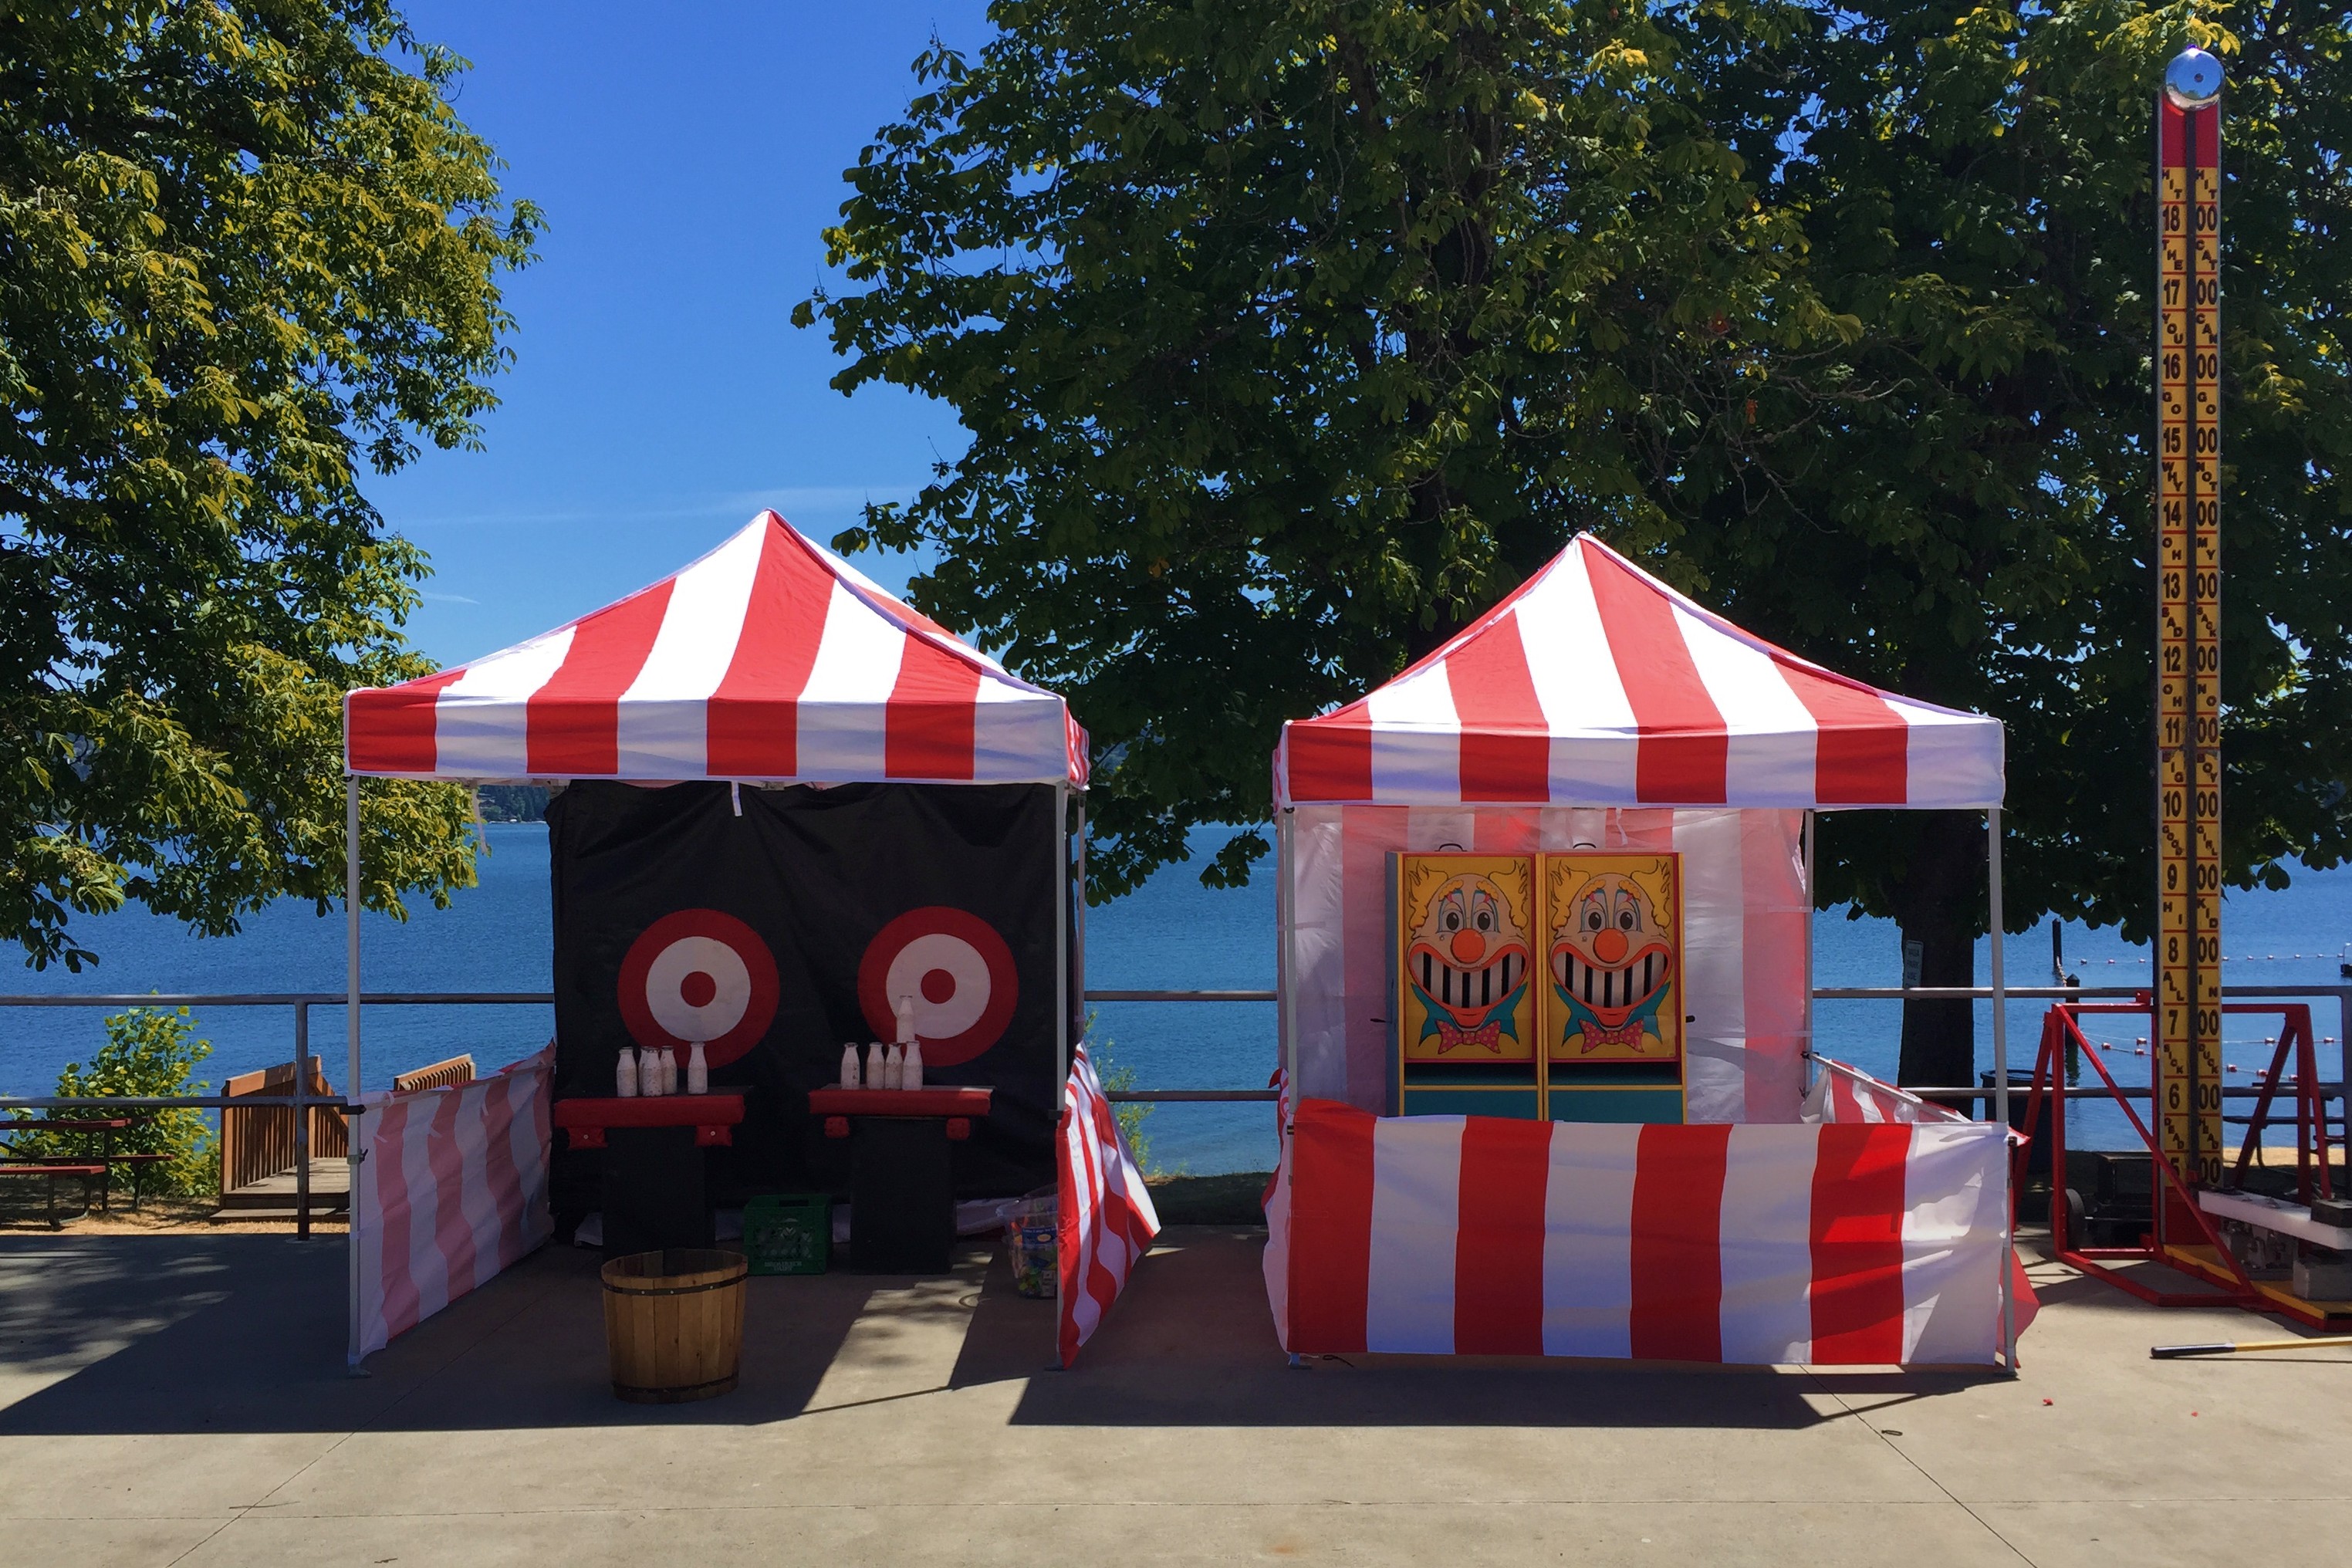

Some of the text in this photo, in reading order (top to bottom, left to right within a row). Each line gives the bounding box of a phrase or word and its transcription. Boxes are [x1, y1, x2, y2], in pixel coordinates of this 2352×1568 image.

[2162, 169, 2217, 199] HIT HIT
[2163, 205, 2218, 231] 18 00
[2162, 240, 2217, 270] THE CAT
[2164, 279, 2218, 305] 17 00
[2161, 313, 2218, 344] YOU CAN
[2163, 353, 2218, 379] 16 00
[2162, 391, 2217, 414] GO GO
[2163, 427, 2218, 453] 15 00
[2162, 462, 2217, 492] WHY NOT
[2164, 501, 2218, 526] 14 00
[2162, 538, 2215, 560] OH MY
[2163, 573, 2218, 599] 13 00
[2164, 646, 2218, 672] 12 00
[2163, 684, 2216, 707] OH NO
[2166, 717, 2218, 743] 11 00
[2164, 791, 2219, 817] 10 00
[2162, 826, 2217, 856] GOOD GIRL
[2168, 863, 2218, 890] 9 00
[2164, 898, 2218, 928] HI KID
[2168, 937, 2219, 962] 8 00
[2164, 972, 2217, 1002] ALL IN
[2169, 1009, 2219, 1035] 7 00
[2164, 1044, 2219, 1074] SICK DUCK
[2169, 1083, 2220, 1110] 6 00
[2164, 1118, 2219, 1149] DEAD HEAD
[2201, 1157, 2220, 1183] 00
